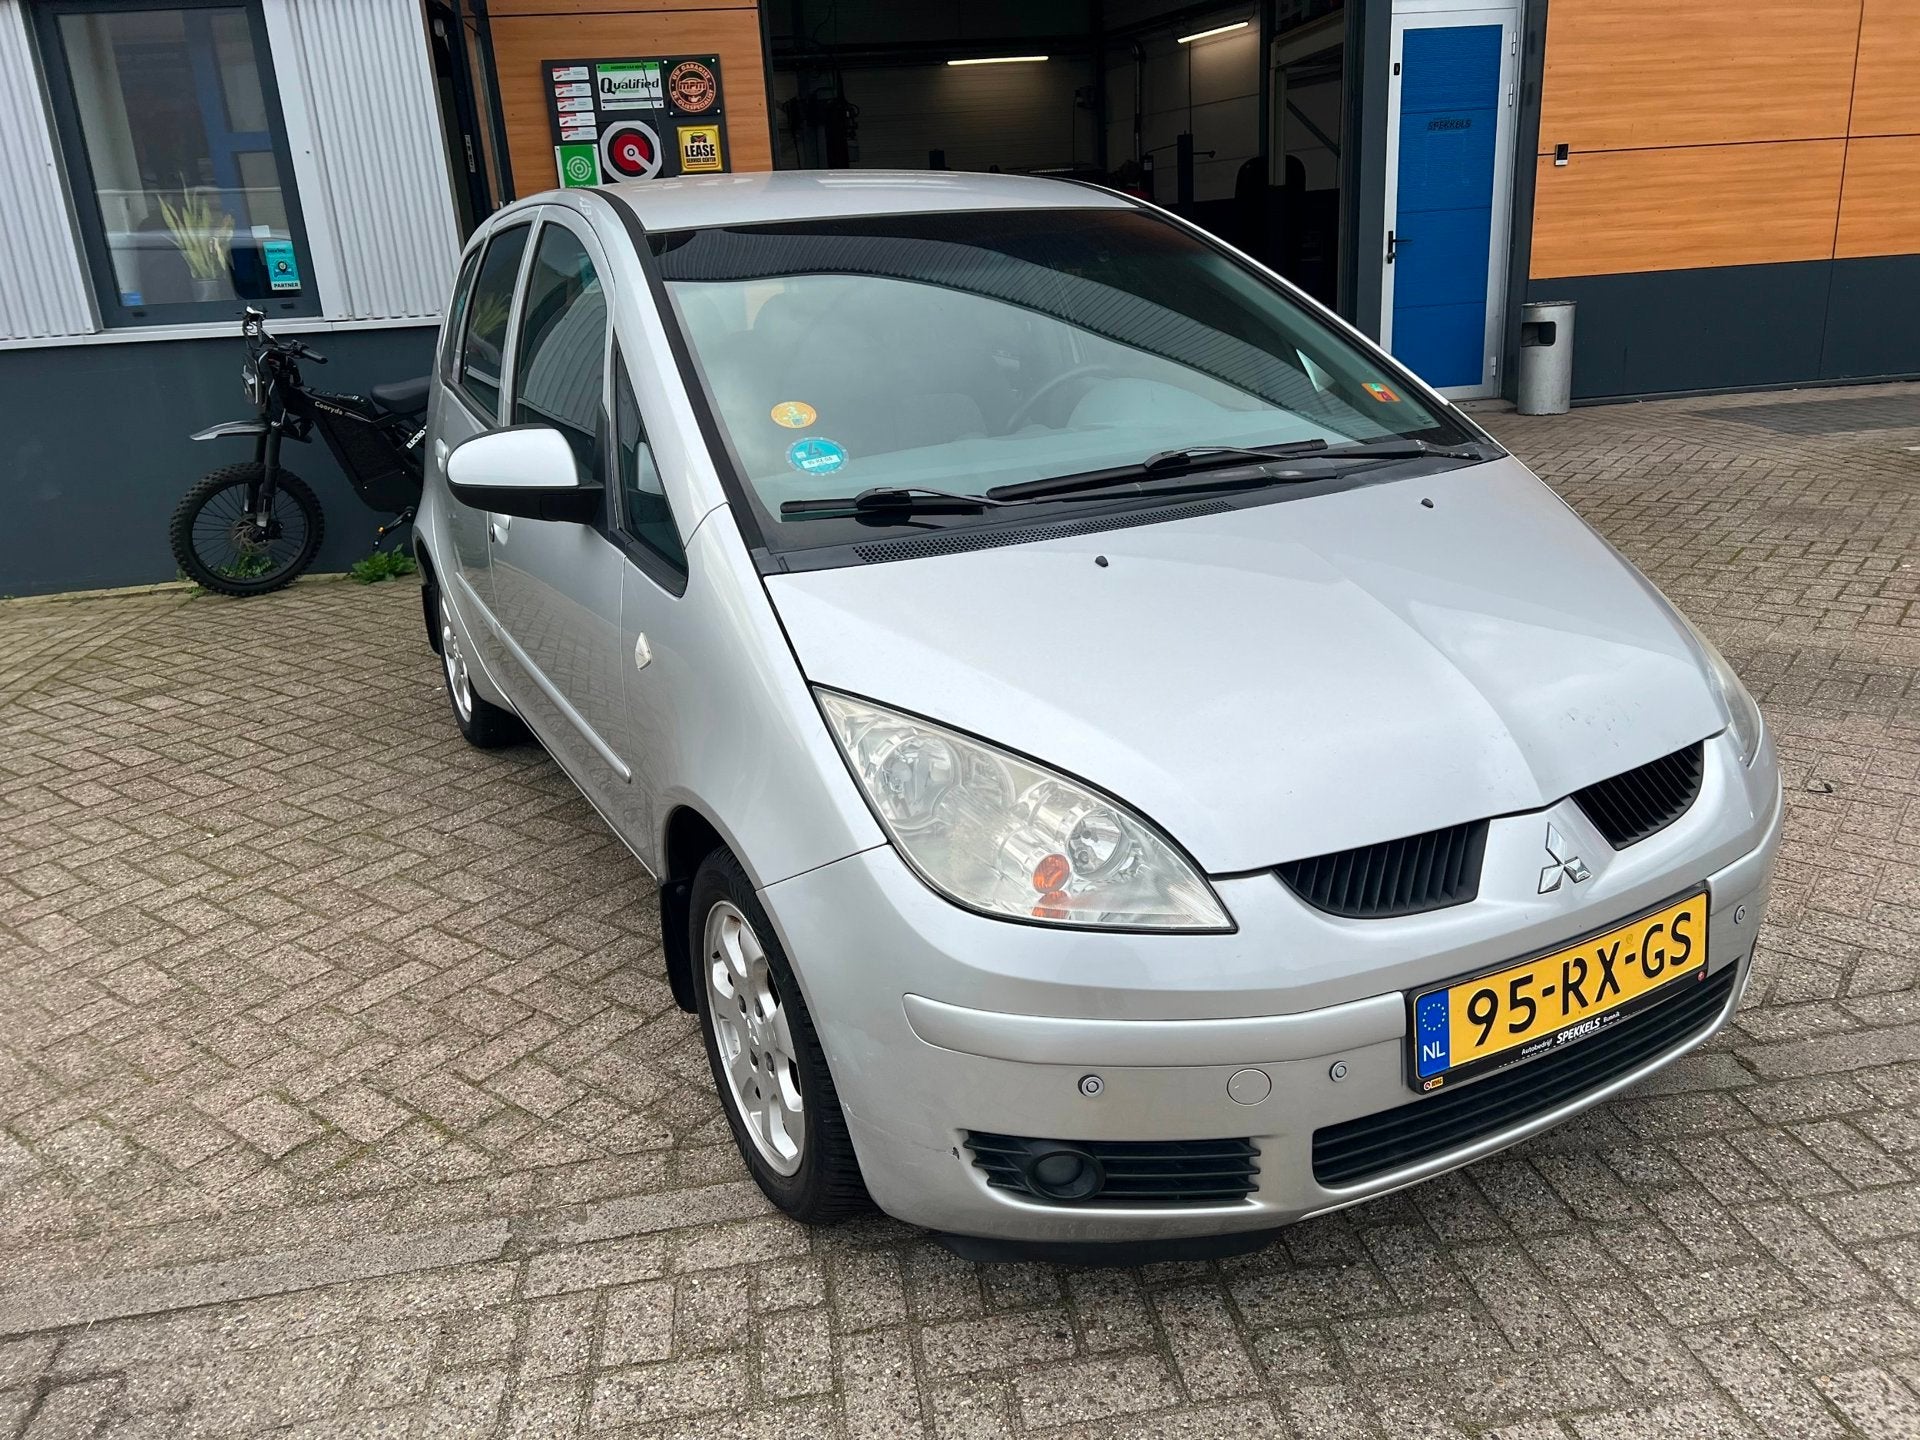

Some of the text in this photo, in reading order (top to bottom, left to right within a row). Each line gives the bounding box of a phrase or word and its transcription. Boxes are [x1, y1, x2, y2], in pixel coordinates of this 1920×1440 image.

[681, 63, 711, 79] GARAGIST
[600, 77, 659, 95] Qualified
[684, 144, 716, 157] LEASE
[1467, 911, 1692, 1047] 95-RX-GS
[1556, 1017, 1601, 1044] SPEKKELS
[1423, 1040, 1446, 1062] NL
